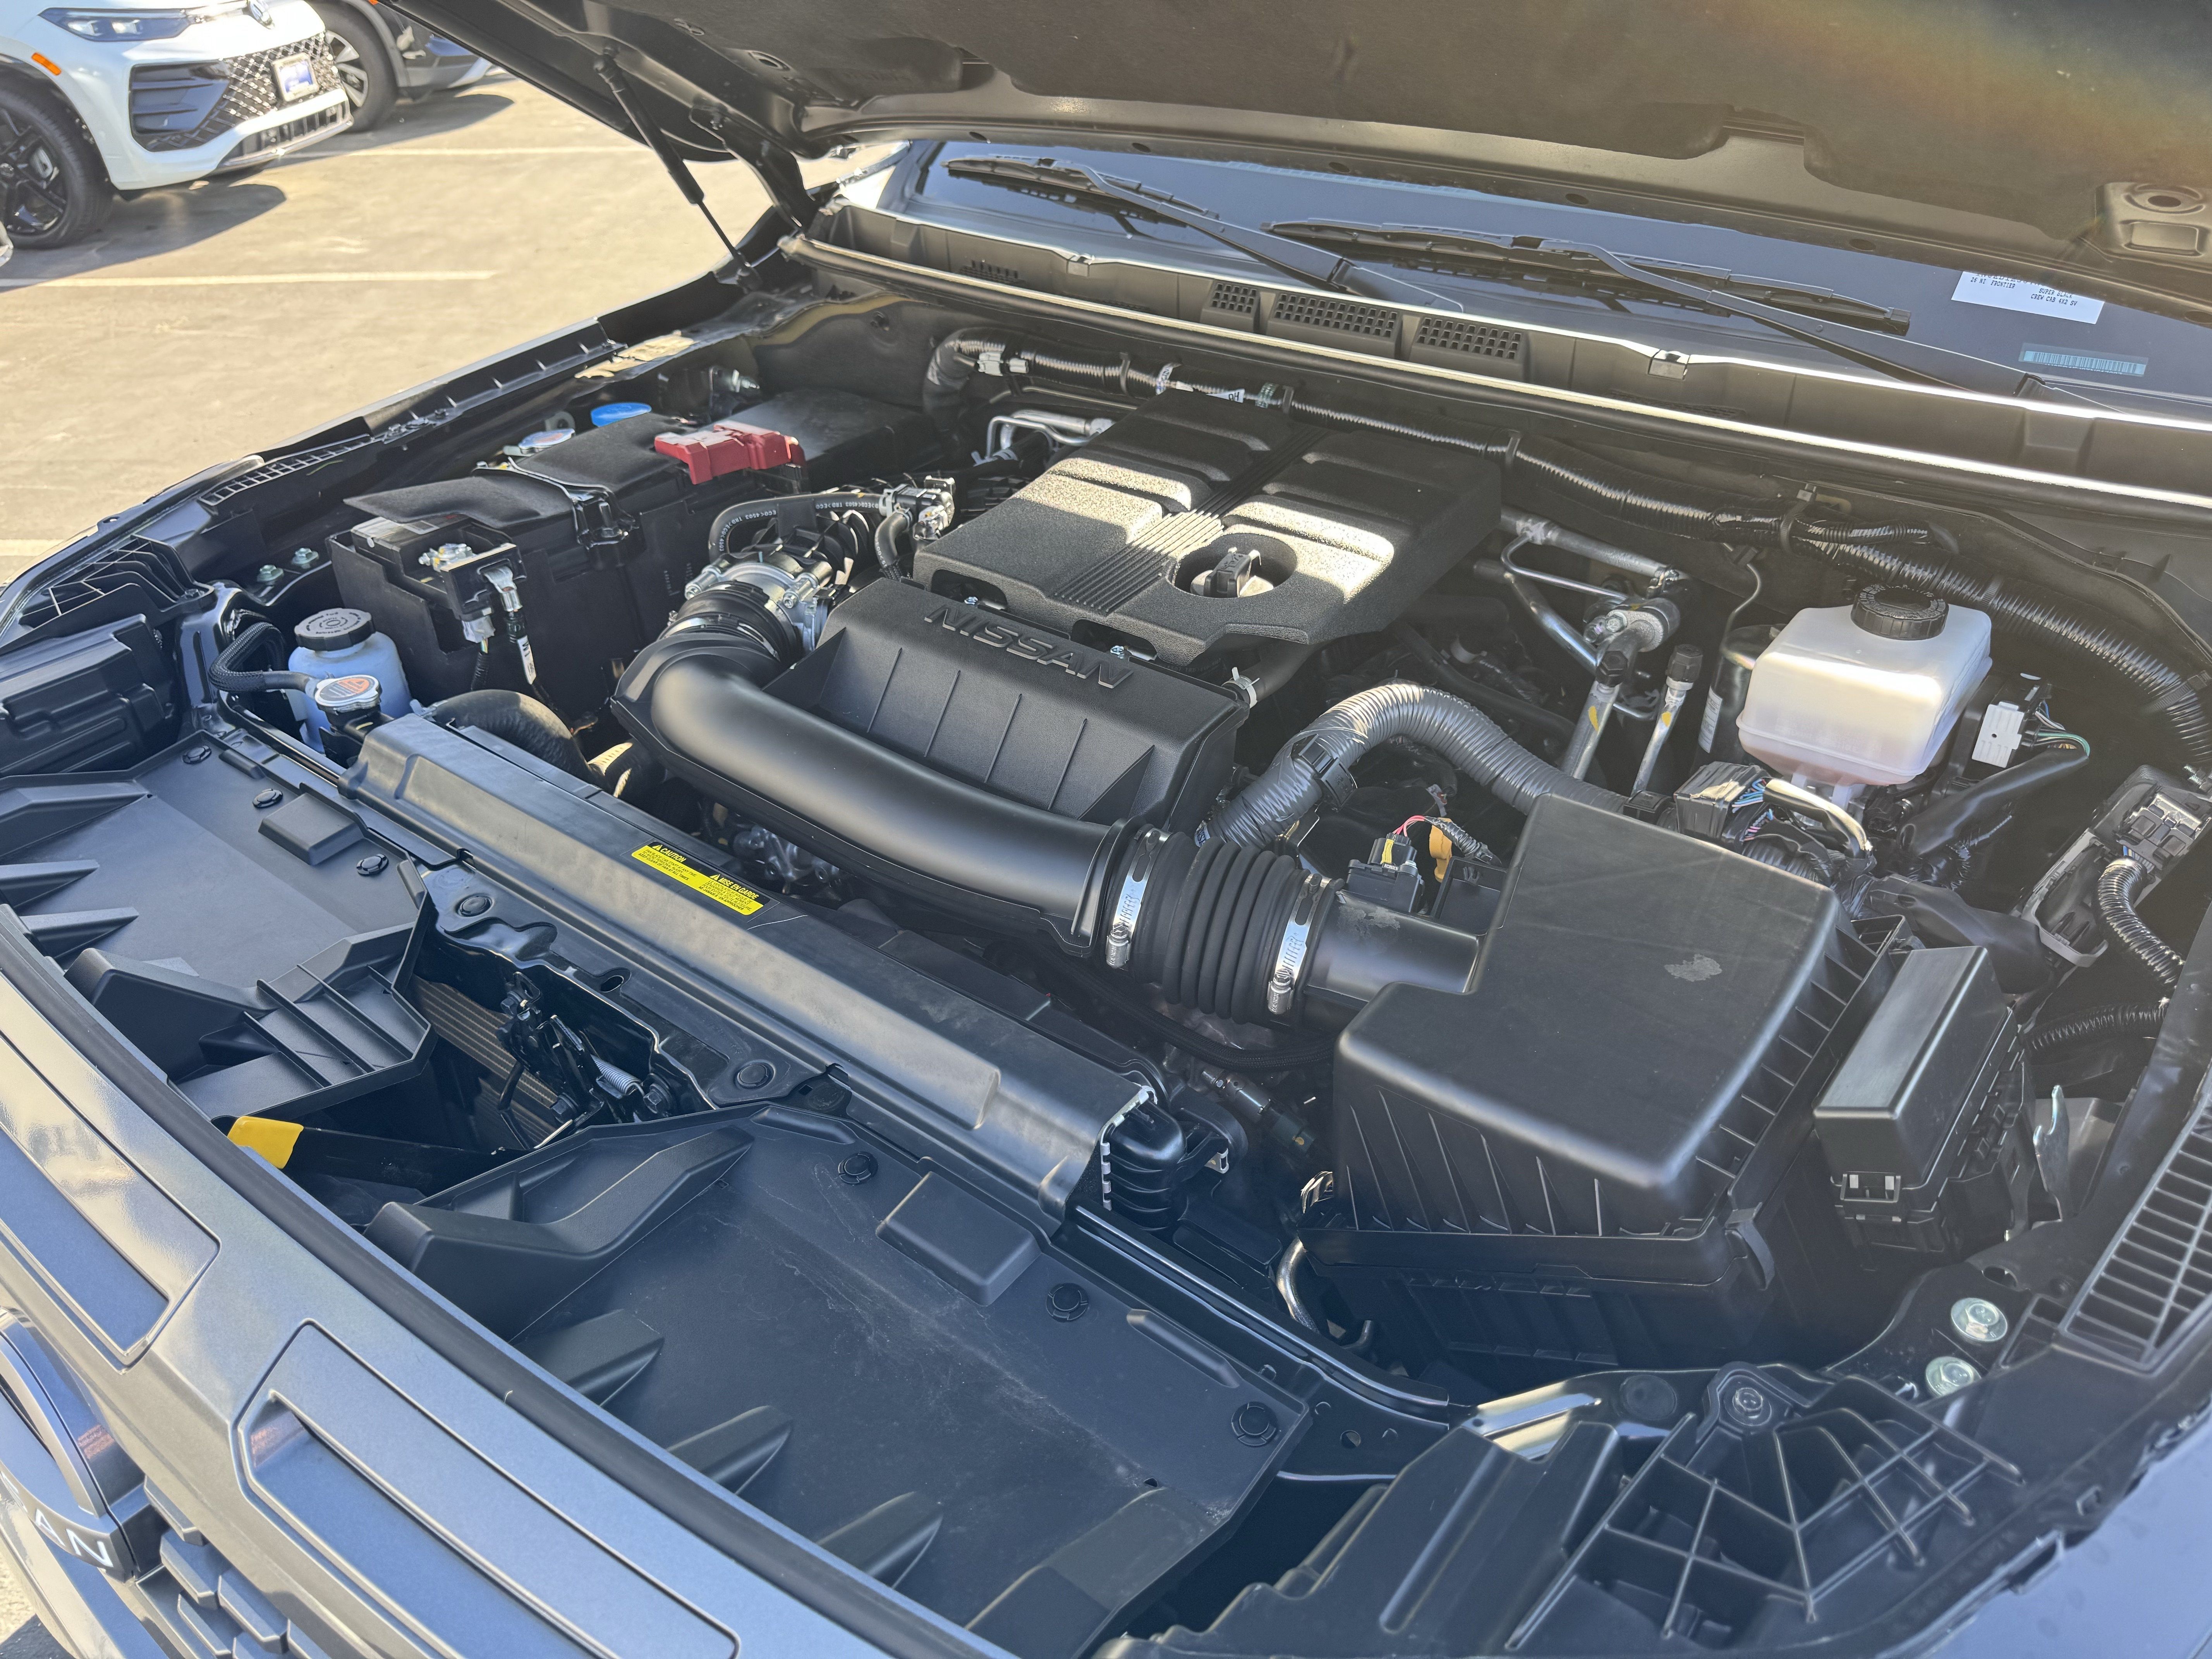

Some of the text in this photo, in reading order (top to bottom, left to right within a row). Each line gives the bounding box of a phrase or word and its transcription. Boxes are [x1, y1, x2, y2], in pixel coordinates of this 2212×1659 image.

[1990, 280, 2016, 289] FRONTIER
[924, 605, 1134, 689] NISSAN
[660, 848, 686, 863] CAUTION
[718, 877, 759, 900] MISE EN GARDE
